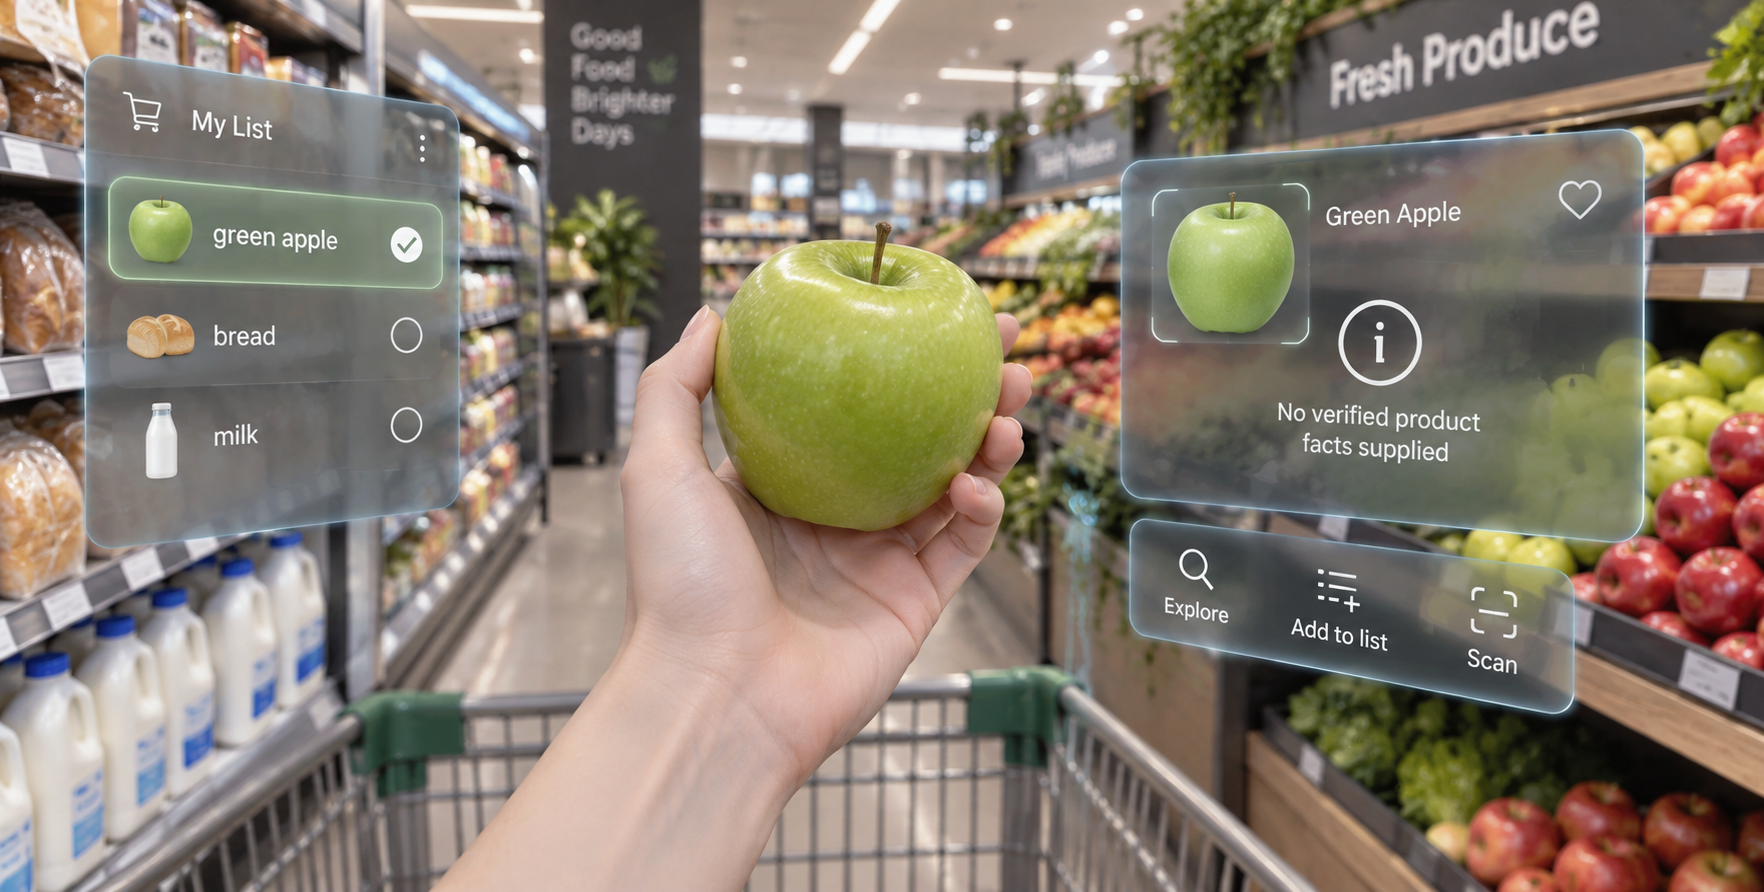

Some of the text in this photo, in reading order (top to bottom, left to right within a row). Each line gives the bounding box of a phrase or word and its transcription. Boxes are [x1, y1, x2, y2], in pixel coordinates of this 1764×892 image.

[571, 22, 642, 51] Good
[571, 53, 635, 82] Food
[1330, 1, 1600, 109] Fresh Produce
[571, 85, 675, 119] Brighter
[192, 109, 273, 141] My List
[571, 116, 634, 150] Days
[1326, 200, 1461, 228] Green Apple
[213, 227, 338, 254] green apple
[214, 324, 276, 346] bread
[1278, 402, 1481, 433] No verified product
[214, 423, 259, 447] milk
[1302, 432, 1449, 464] facts supplied
[1164, 596, 1229, 624] Explore
[1291, 618, 1388, 652] Add to list
[1467, 648, 1517, 675] Scan
